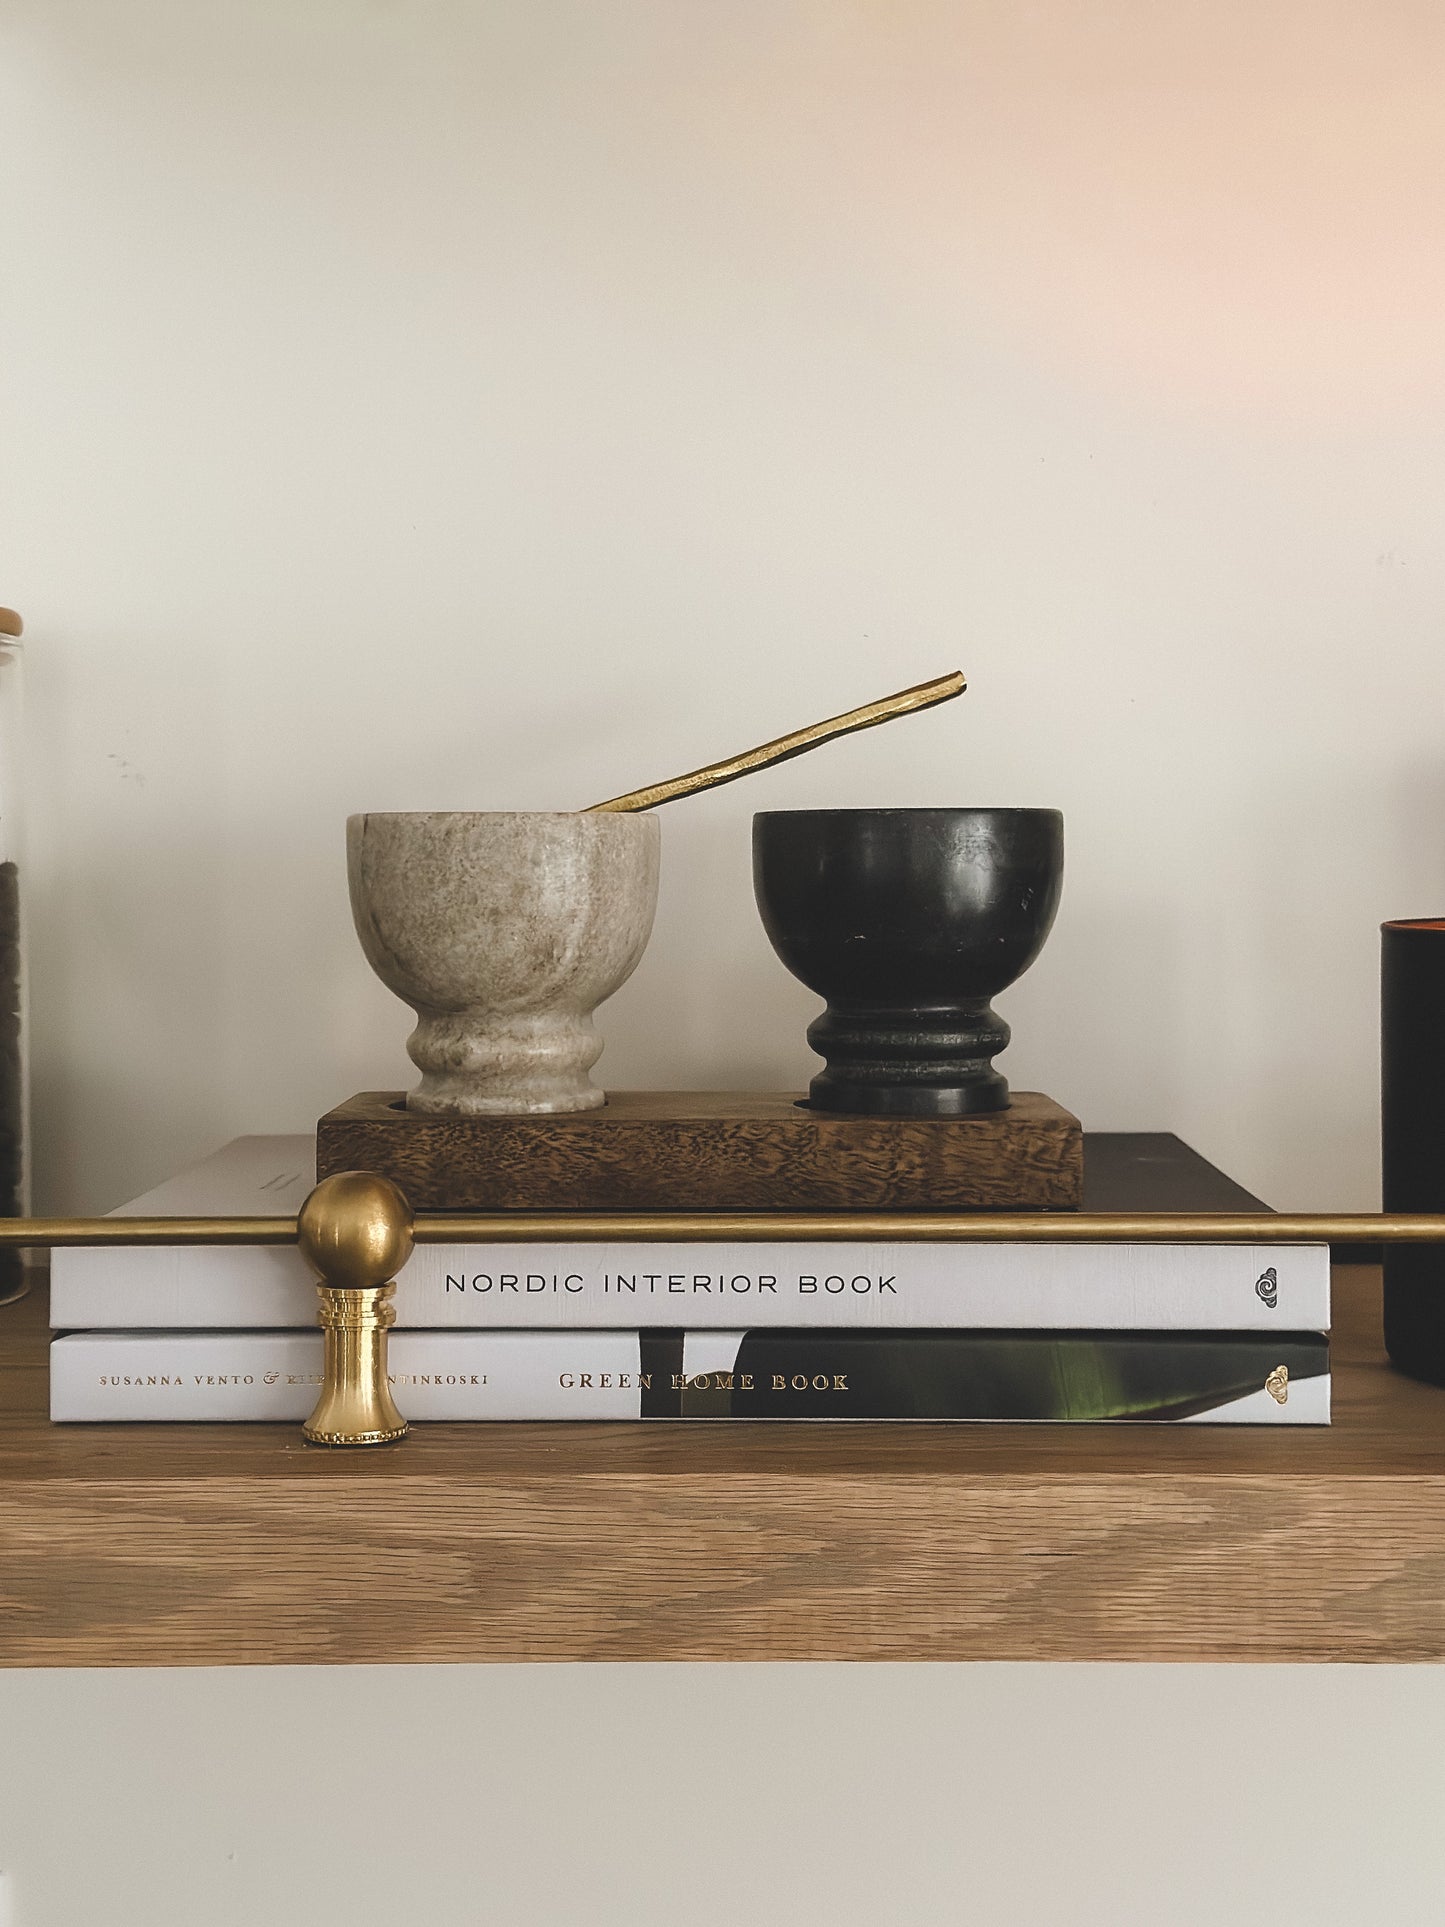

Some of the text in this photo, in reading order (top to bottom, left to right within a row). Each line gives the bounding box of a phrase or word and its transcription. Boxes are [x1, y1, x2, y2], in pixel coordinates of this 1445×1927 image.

[445, 1273, 898, 1294] NORDIC INTERIOR BOOK
[99, 1375, 184, 1386] SUSANNA
[194, 1375, 255, 1386] VENTO
[263, 1371, 280, 1385] &
[387, 1375, 488, 1385] NTINKOSKI
[559, 1373, 850, 1391] GREEN HOME BOOK
